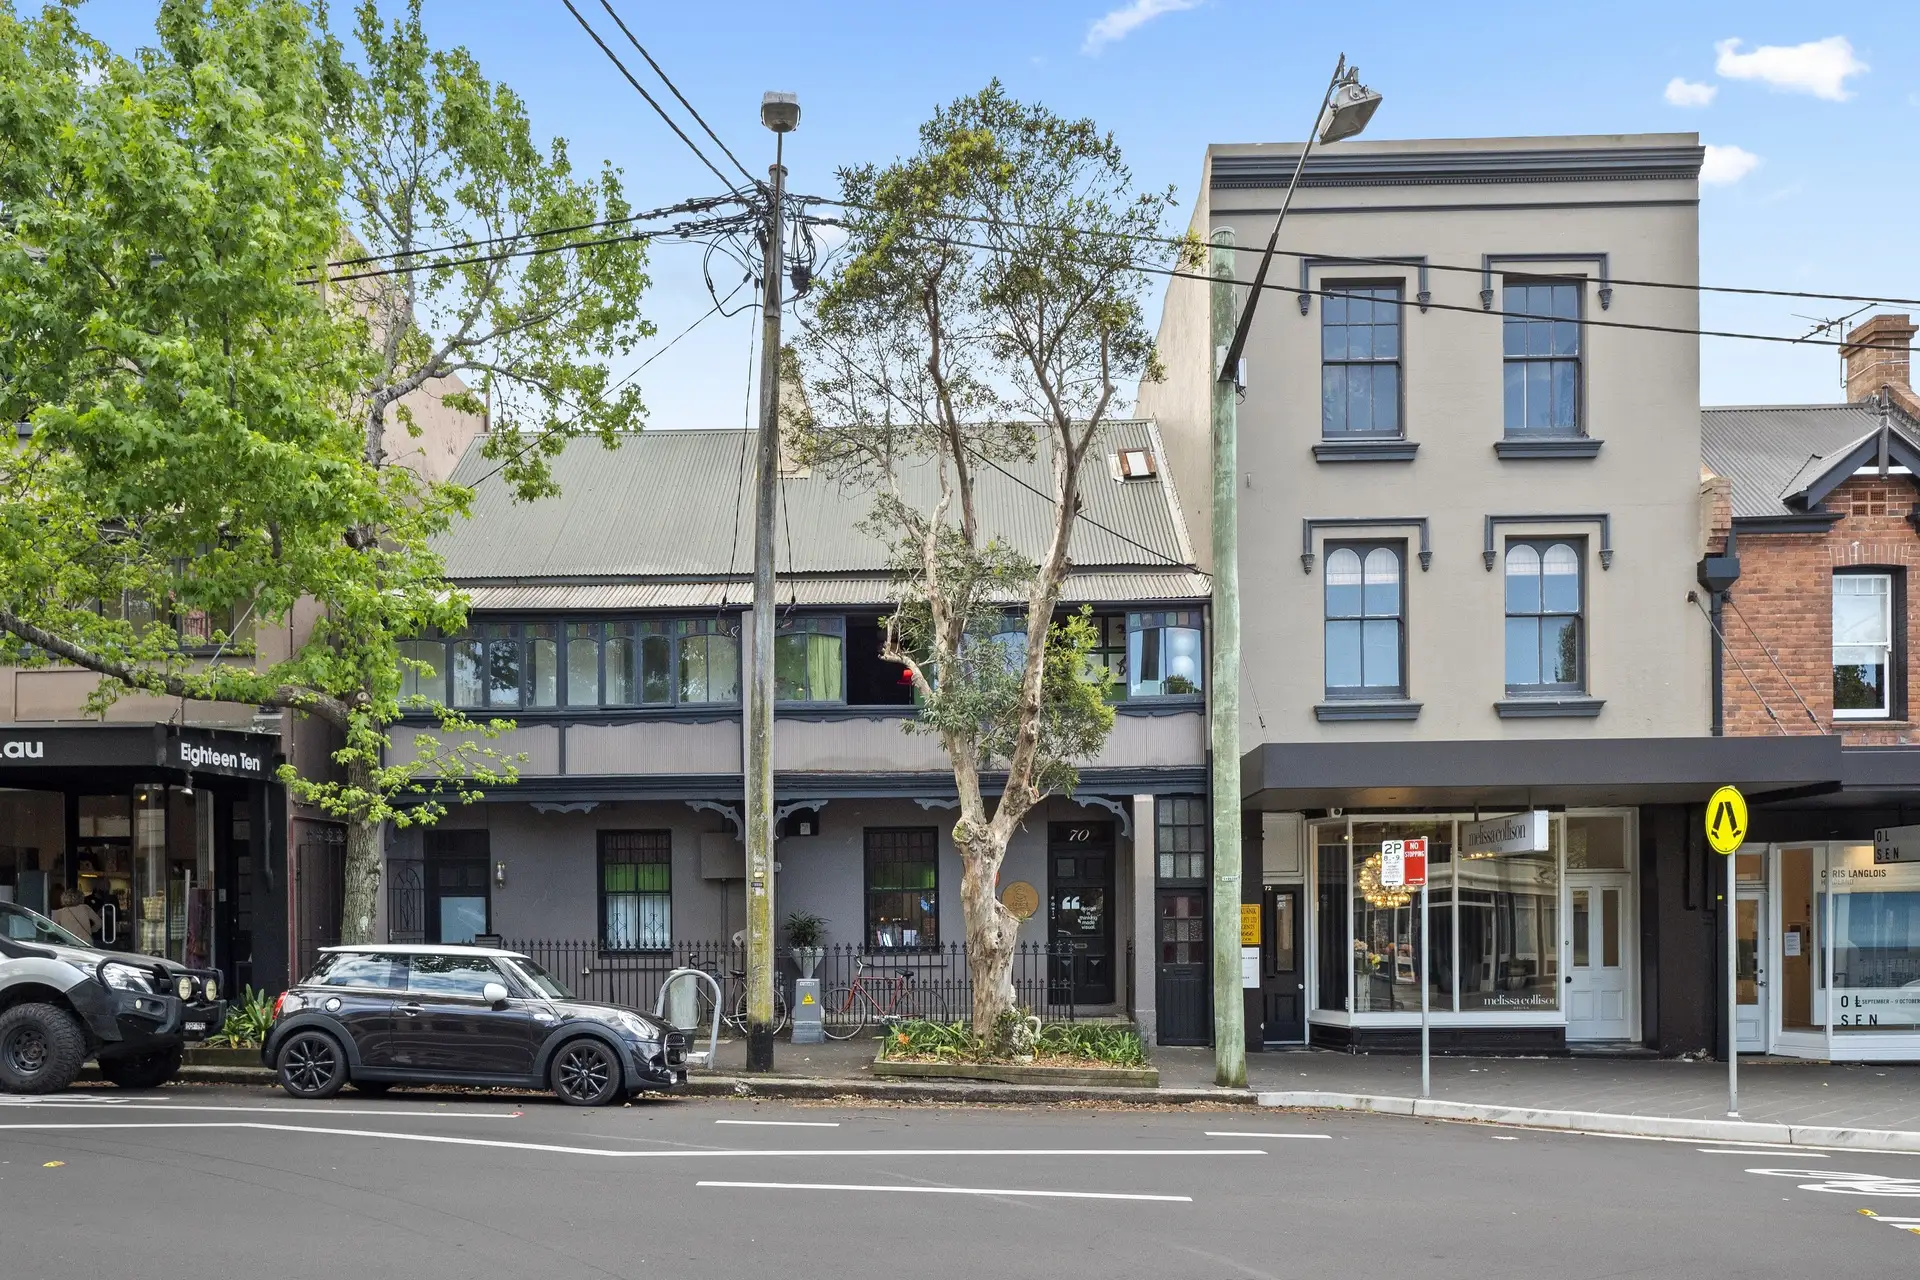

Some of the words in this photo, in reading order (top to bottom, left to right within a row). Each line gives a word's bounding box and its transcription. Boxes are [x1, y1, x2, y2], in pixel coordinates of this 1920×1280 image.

[181, 742, 238, 767] Eighteen
[240, 752, 260, 771] Ten
[1069, 829, 1090, 841] 70
[1384, 843, 1402, 854] 2P
[1409, 842, 1419, 850] NO
[1404, 850, 1425, 858] STOPPING
[1820, 869, 1846, 878] CRIS
[1848, 869, 1887, 878] LANGLOIS
